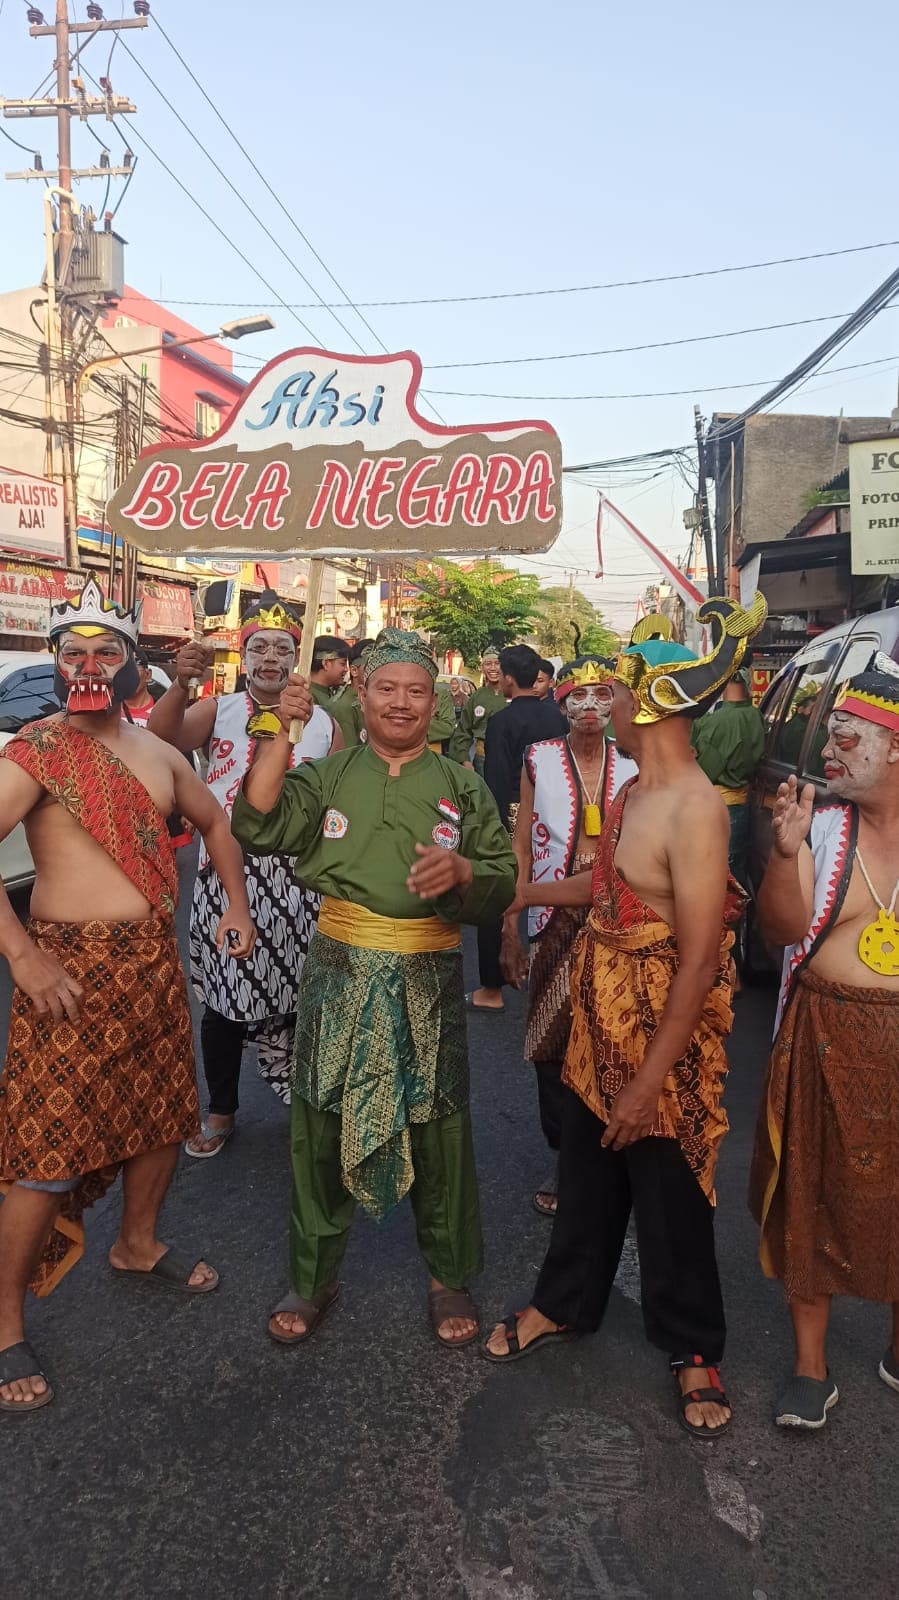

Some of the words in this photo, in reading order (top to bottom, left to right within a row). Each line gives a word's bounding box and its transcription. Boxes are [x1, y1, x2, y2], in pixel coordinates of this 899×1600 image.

[245, 369, 385, 430] Aksi
[19, 508, 45, 528] AJA!
[120, 461, 290, 530] BELA
[306, 450, 556, 529] NEGARA
